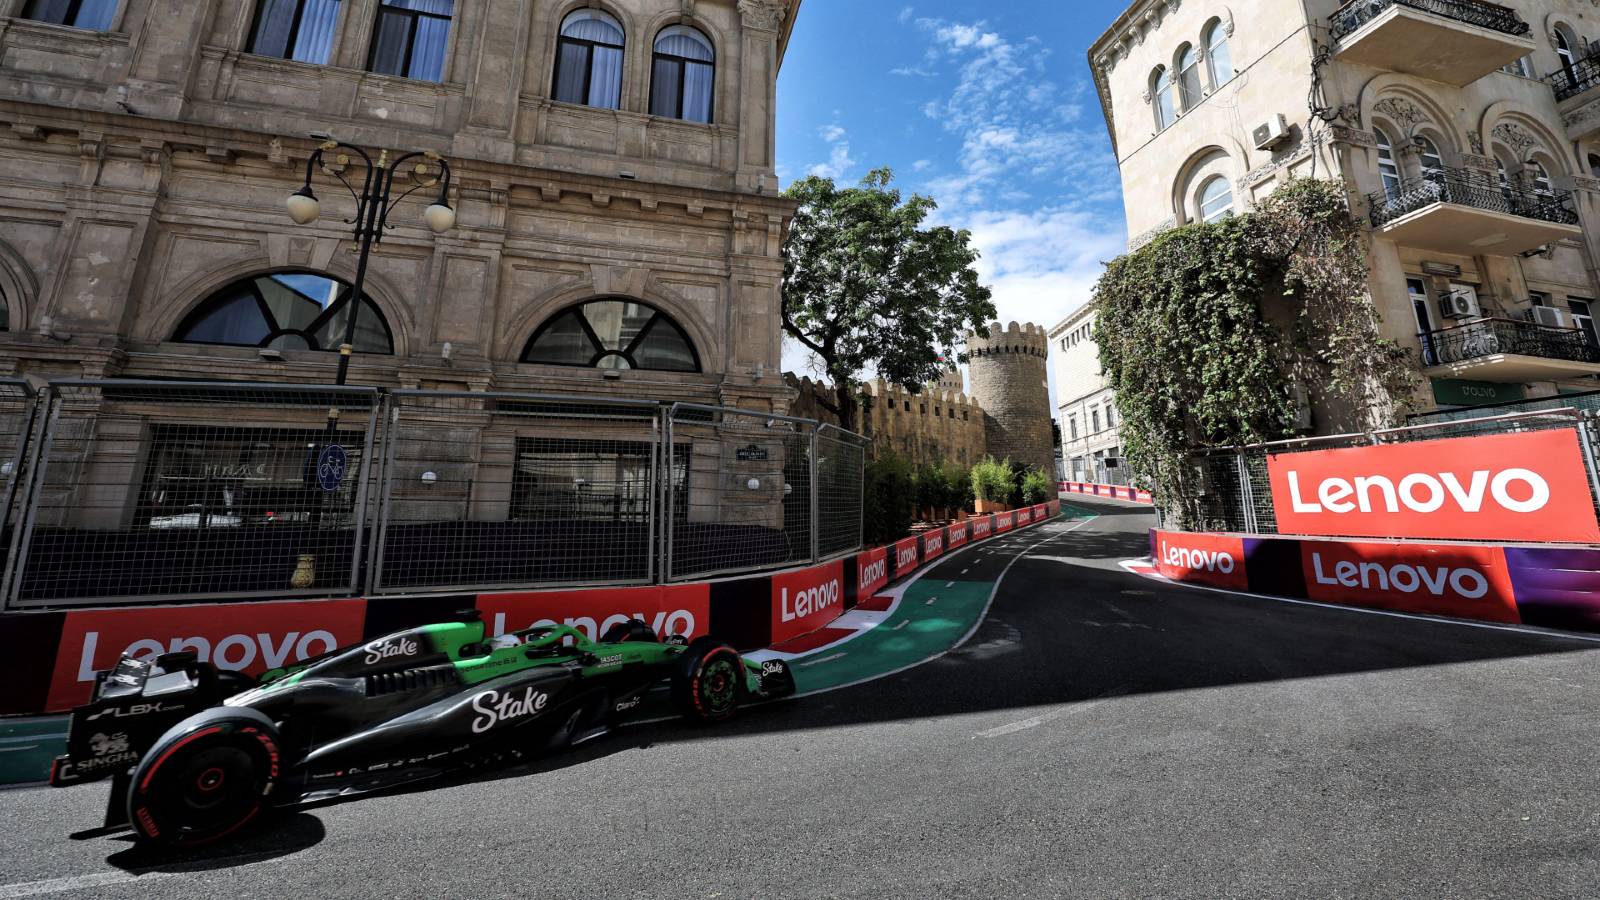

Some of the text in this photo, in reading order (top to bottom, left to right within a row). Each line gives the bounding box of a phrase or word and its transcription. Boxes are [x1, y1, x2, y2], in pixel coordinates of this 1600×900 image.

[1287, 468, 1550, 513] Lenovo
[949, 528, 966, 543] Lenovo
[973, 519, 990, 535] Lenovo
[897, 546, 917, 568] Lenovo
[925, 536, 942, 553] Lenovo
[1162, 540, 1235, 574] Lenovo
[860, 559, 885, 589] Lenovo
[1312, 552, 1489, 600] Lenovo
[781, 578, 839, 623] Lenovo
[364, 638, 417, 665] Stake
[762, 661, 783, 677] Stake
[471, 686, 548, 734] Stake
[77, 751, 139, 770] SINGHA
